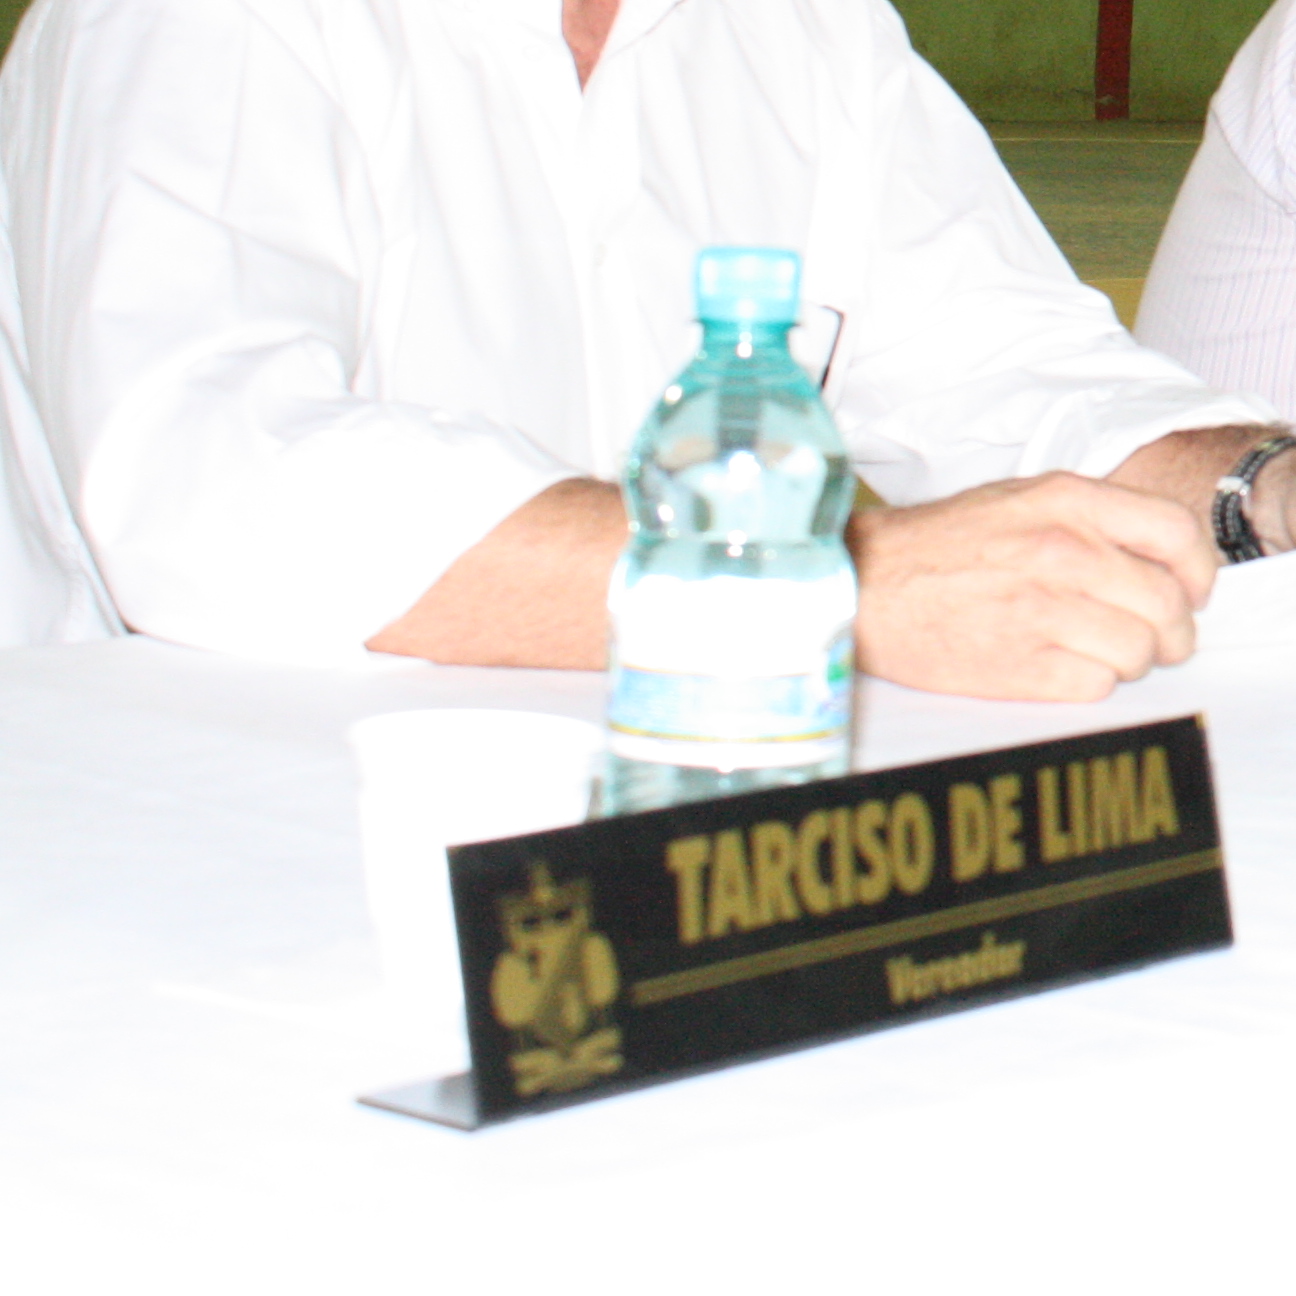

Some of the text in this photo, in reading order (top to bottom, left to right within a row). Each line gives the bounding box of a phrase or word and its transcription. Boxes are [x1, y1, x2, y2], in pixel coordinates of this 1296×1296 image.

[665, 745, 1180, 945] TARCISO DE LIMA
